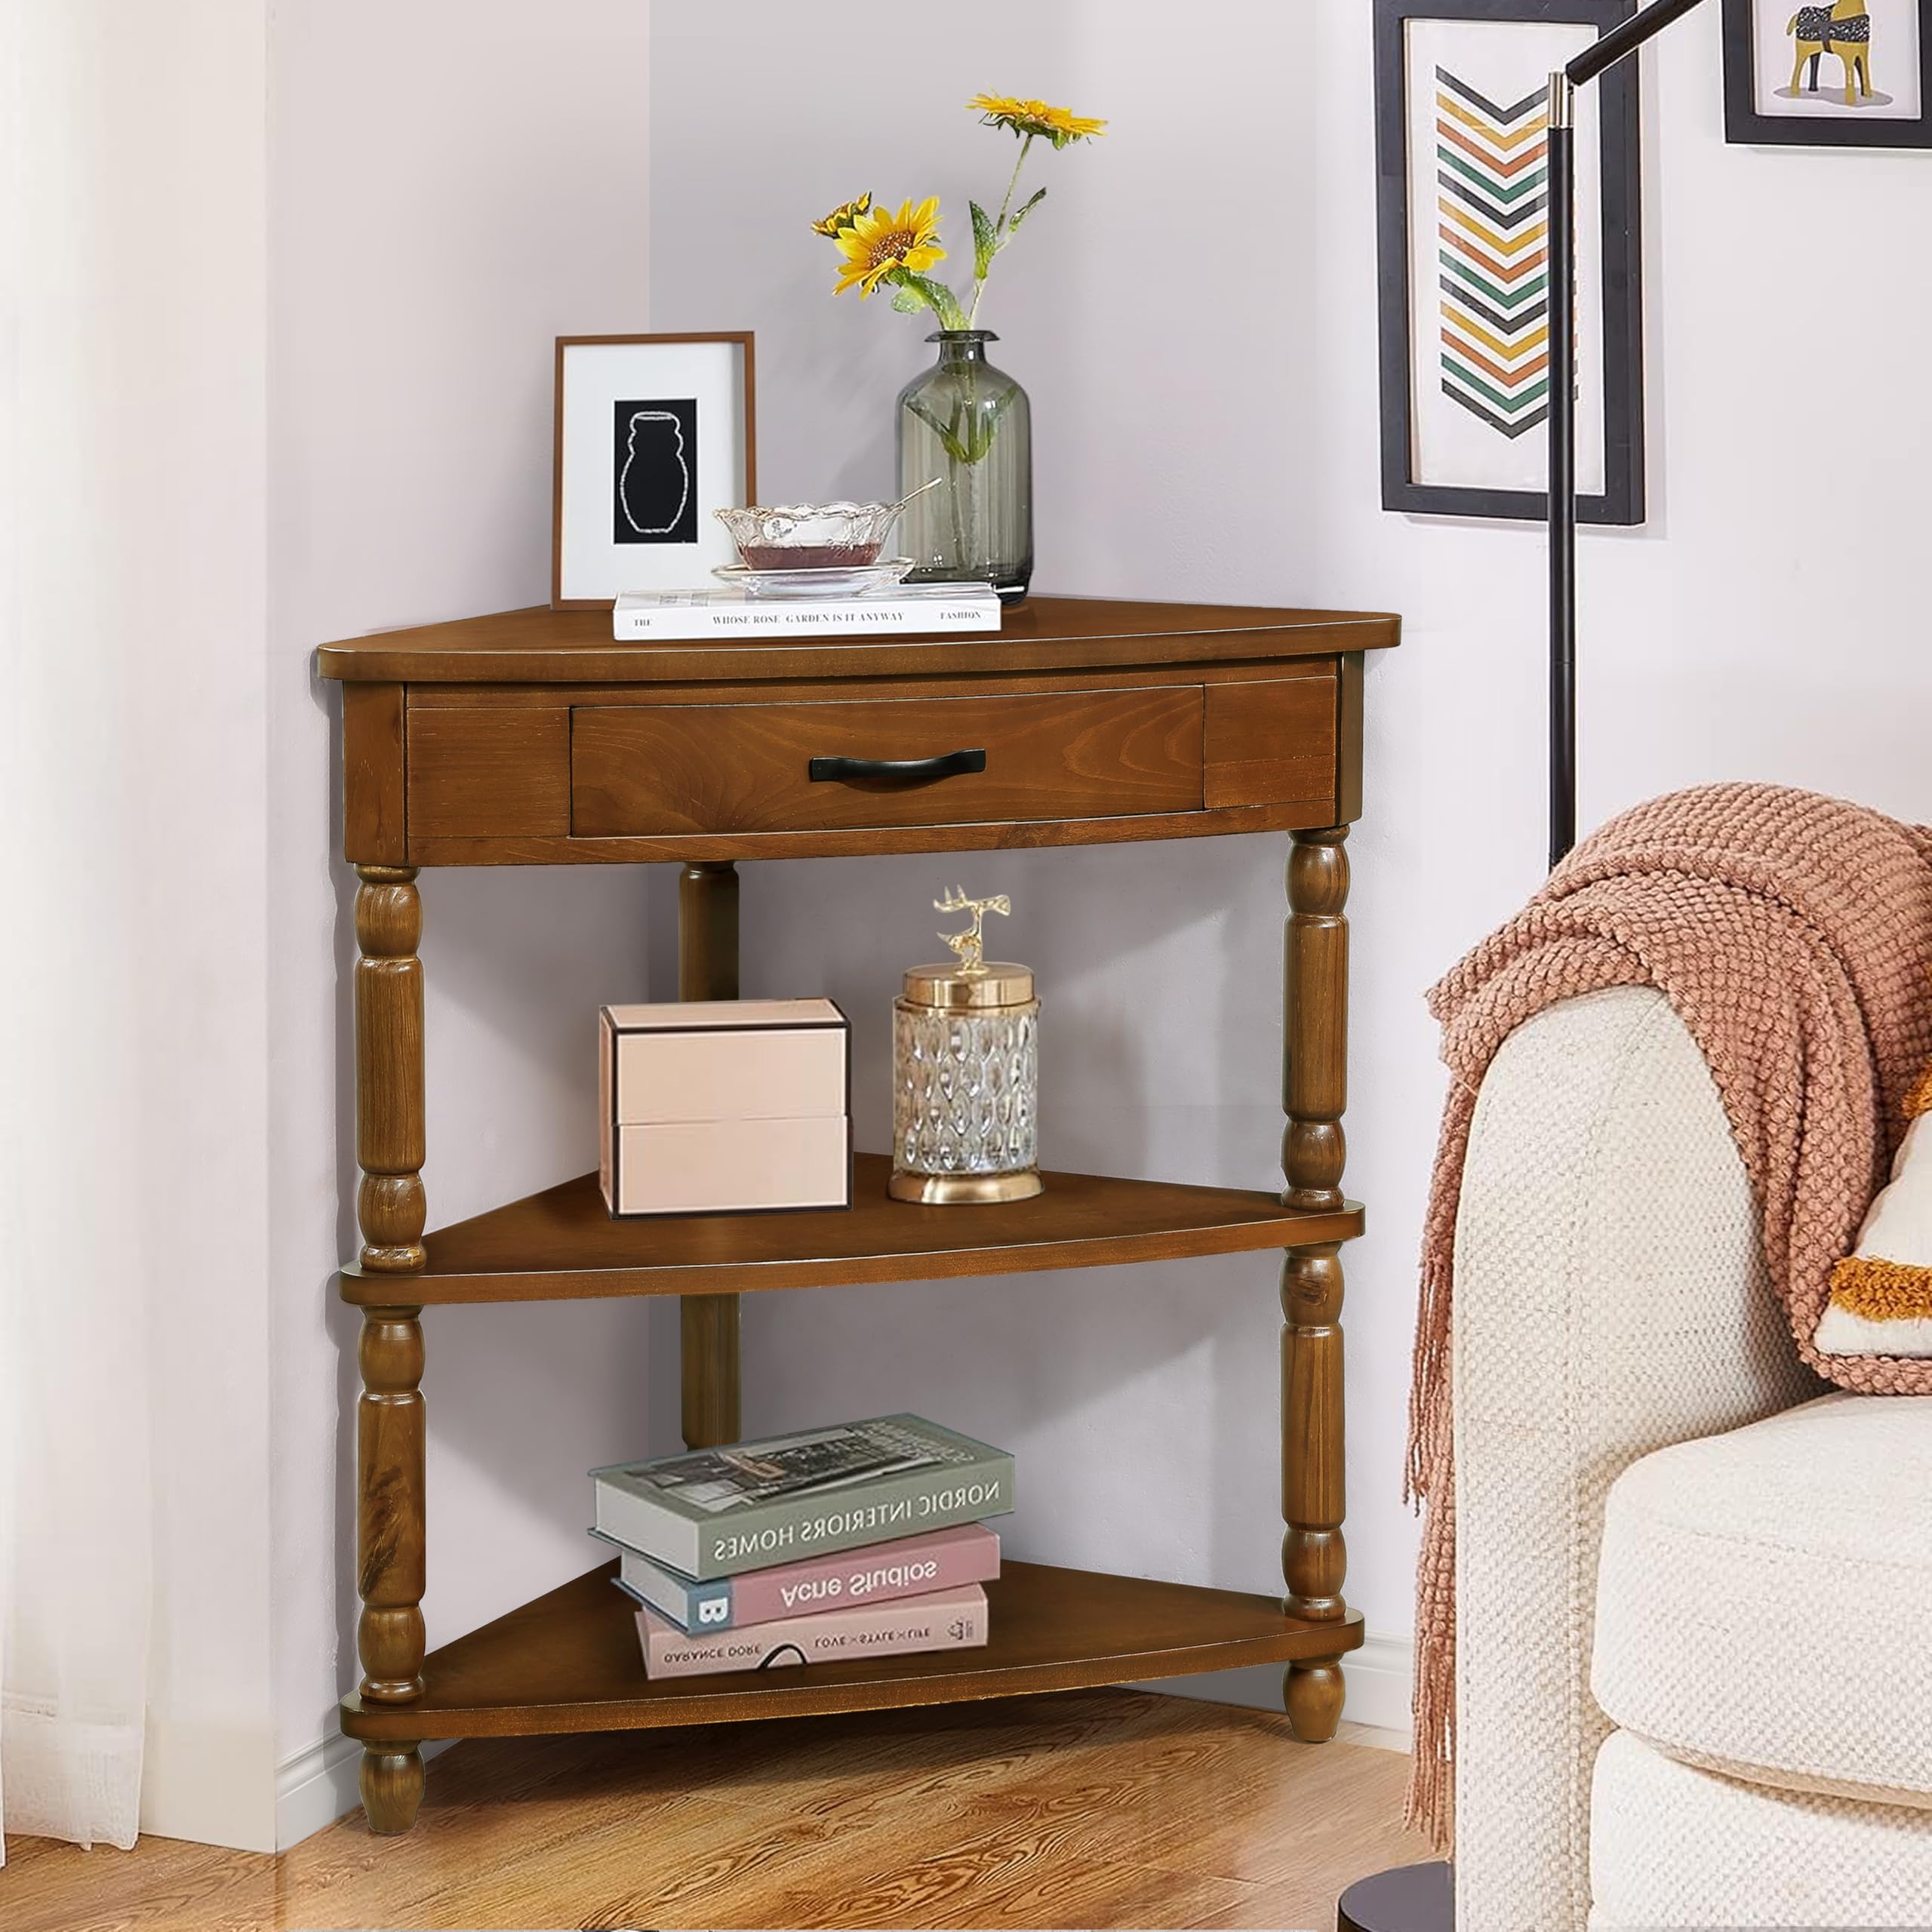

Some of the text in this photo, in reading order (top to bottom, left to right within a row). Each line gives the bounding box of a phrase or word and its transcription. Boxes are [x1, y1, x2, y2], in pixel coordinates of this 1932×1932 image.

[712, 611, 905, 625] WHOSE ROSE GARDEN IS IT ANYWAY
[940, 611, 982, 620] FASHION
[634, 619, 653, 627] THE
